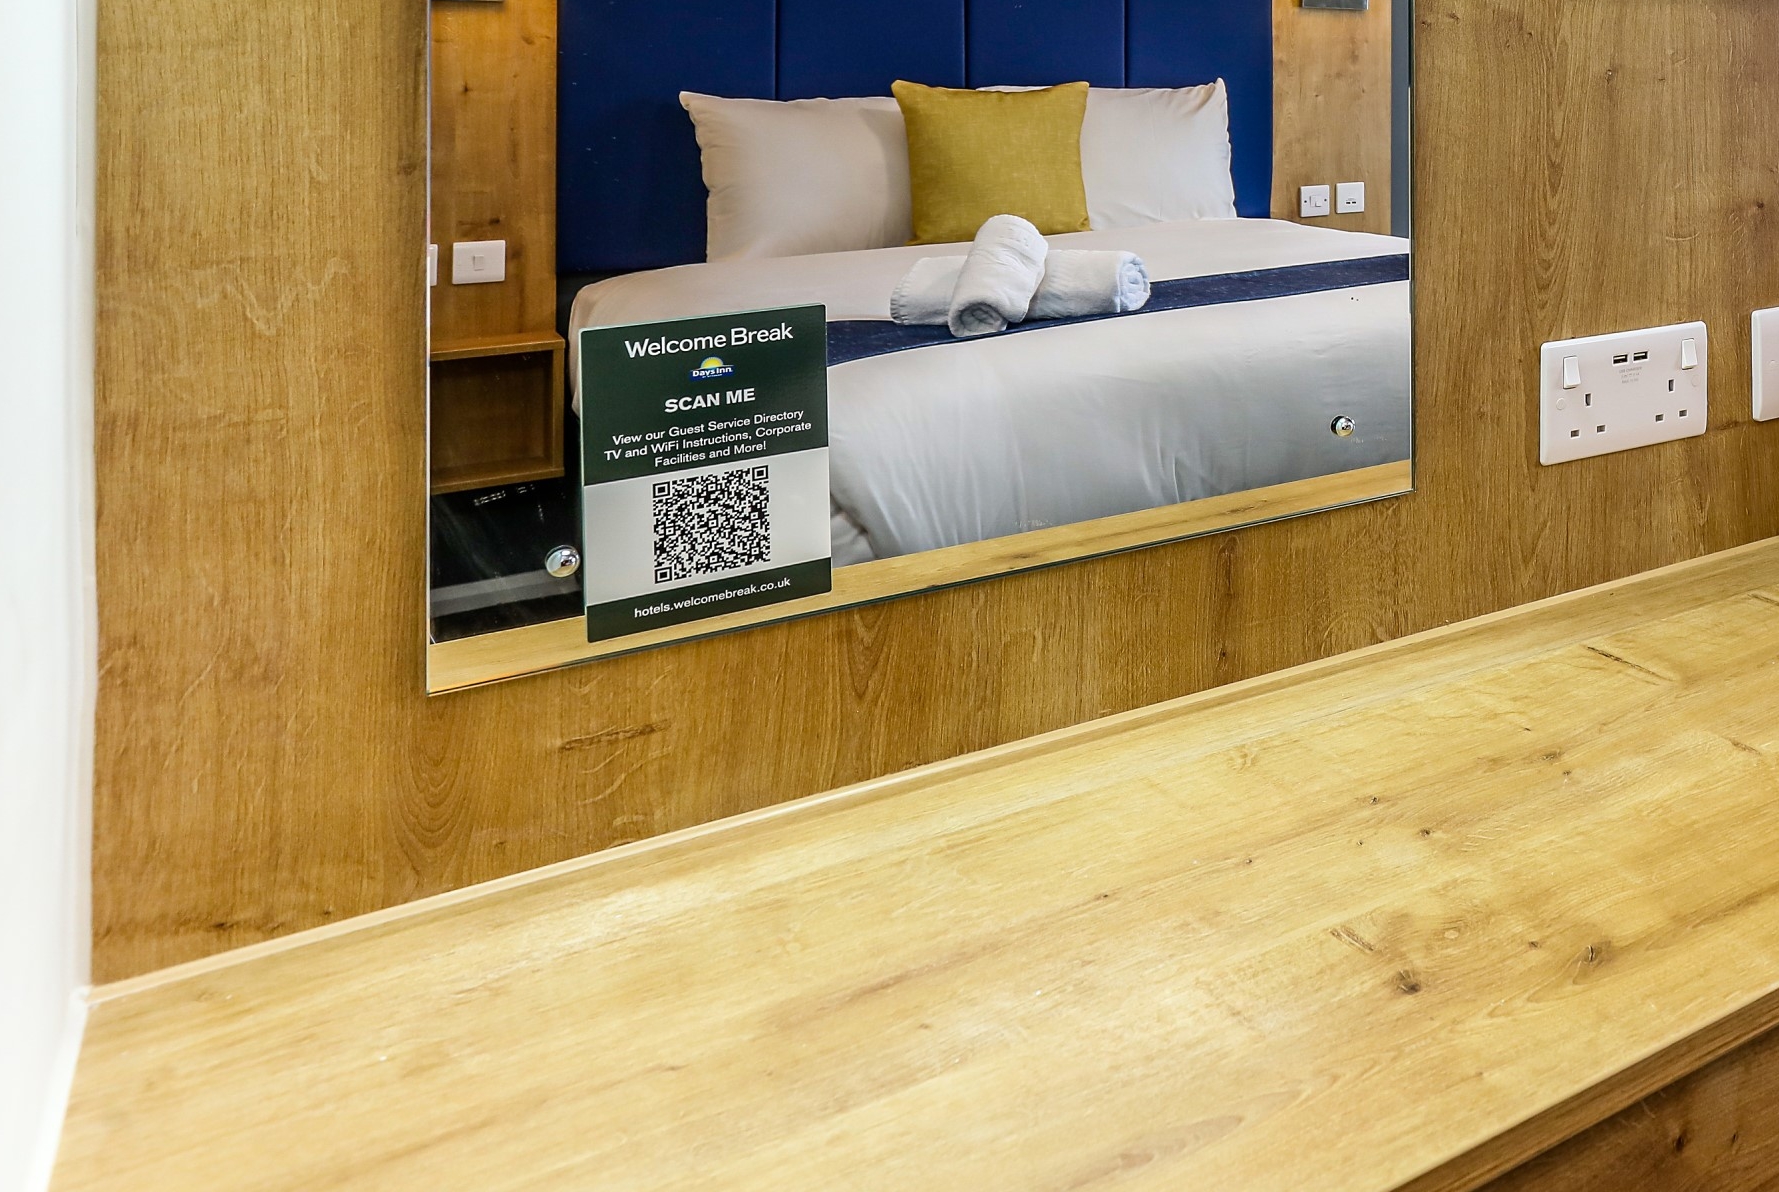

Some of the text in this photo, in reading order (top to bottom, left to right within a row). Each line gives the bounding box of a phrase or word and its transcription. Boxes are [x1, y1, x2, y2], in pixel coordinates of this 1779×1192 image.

[625, 323, 794, 358] Welcome Break
[692, 368, 716, 377] Days
[664, 387, 756, 413] SCAN ME
[604, 422, 812, 461] TV and WiFi Instructions, Corporate
[612, 410, 804, 446] View our Guest Service Directory
[654, 440, 767, 468] Facilities and More!
[634, 577, 791, 618] hotels.welcomebreak.co.uk
